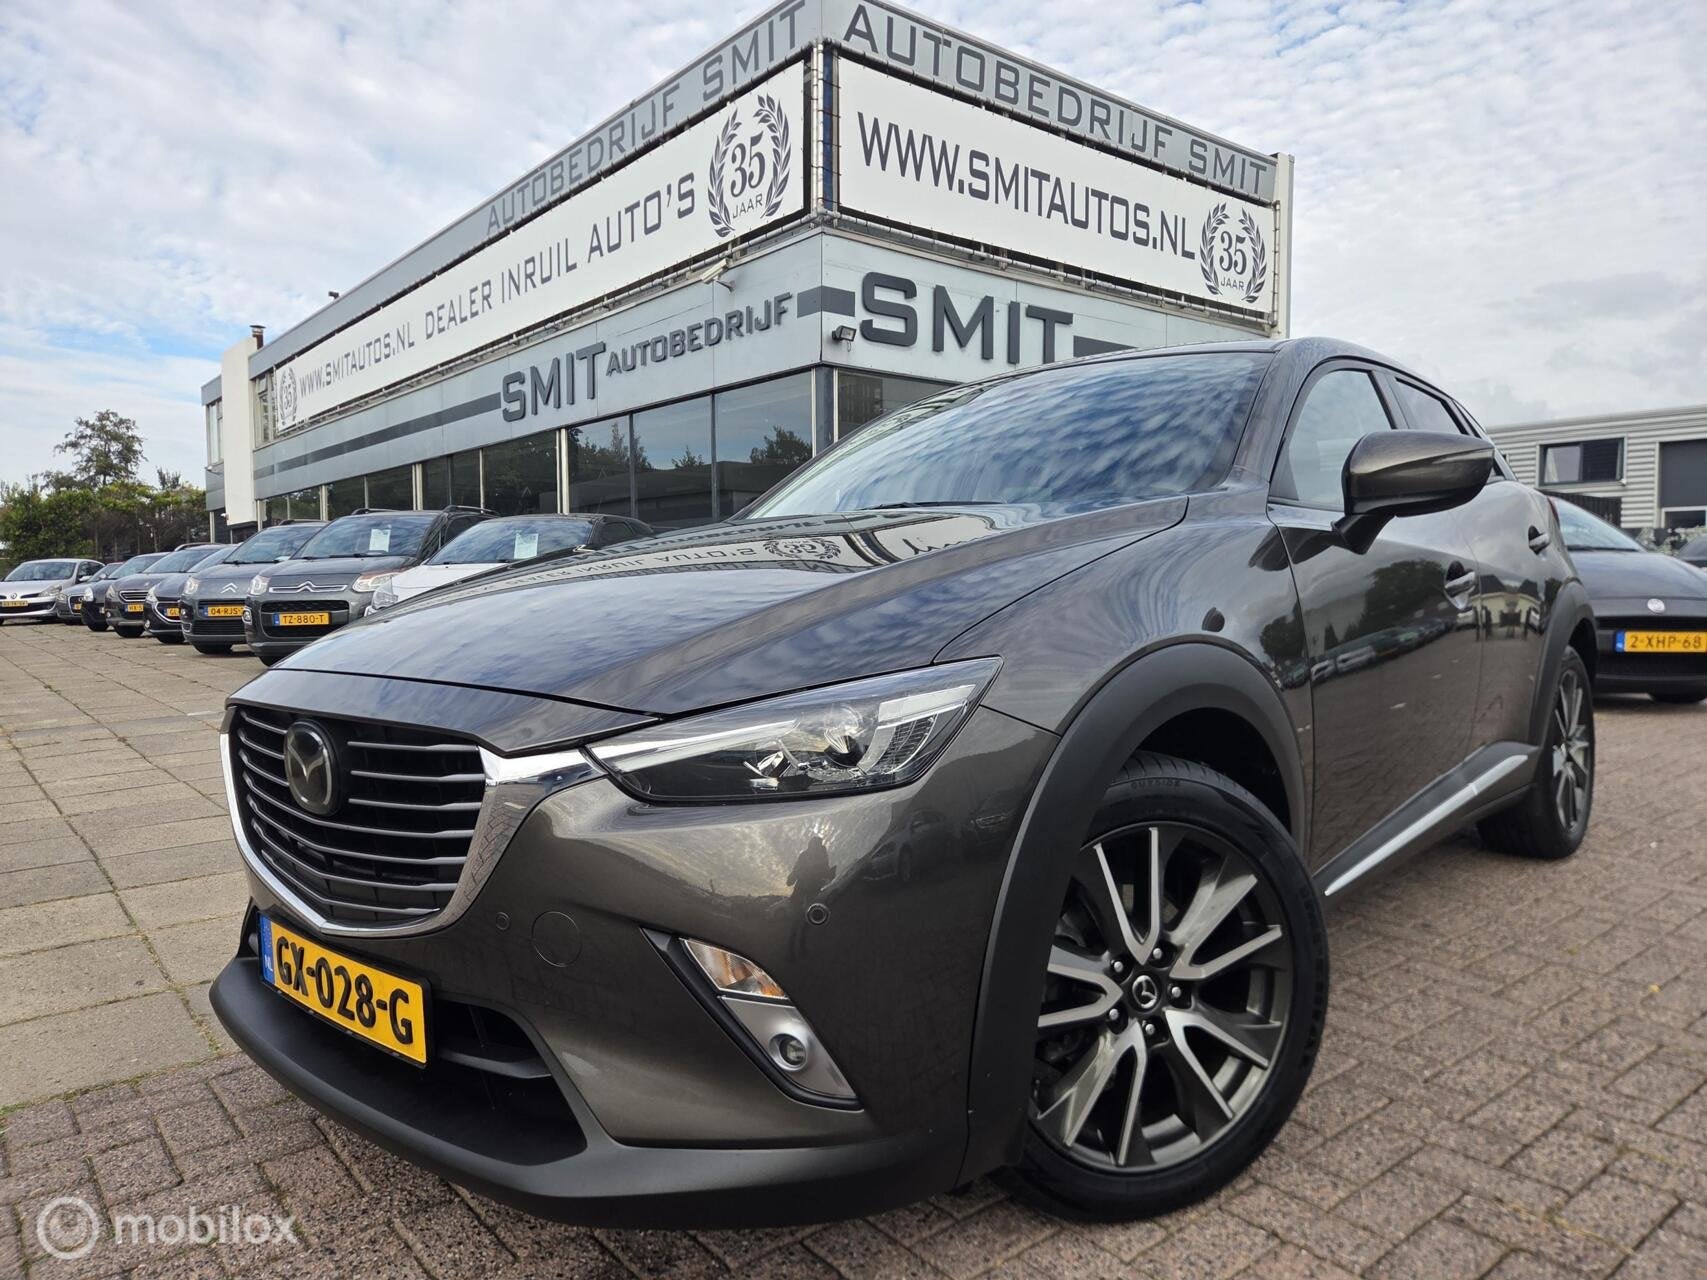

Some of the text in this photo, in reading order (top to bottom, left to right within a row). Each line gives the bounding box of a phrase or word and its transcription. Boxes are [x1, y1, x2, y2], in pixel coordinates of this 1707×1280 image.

[486, 3, 806, 236] AUTOBEDRIJF SMIT
[843, 4, 1267, 194] AUTOBEDRIJF SMIT
[730, 130, 766, 198] 35
[732, 193, 763, 219] JAAR
[857, 111, 1196, 260] WWW.SMITAUTOS.NL
[299, 172, 695, 398] WWW.SMITAUTOS.NL DEALER INRUIL AUTO'S
[1219, 235, 1247, 275] 35
[1220, 276, 1245, 292] JAAR
[502, 291, 793, 423] SMIT AUTOBEDRIJF
[860, 271, 1074, 365] SMIT
[282, 614, 325, 624] TZ-880-T
[1628, 635, 1702, 649] 2-XHP-68
[276, 936, 414, 1046] GX-028-G
